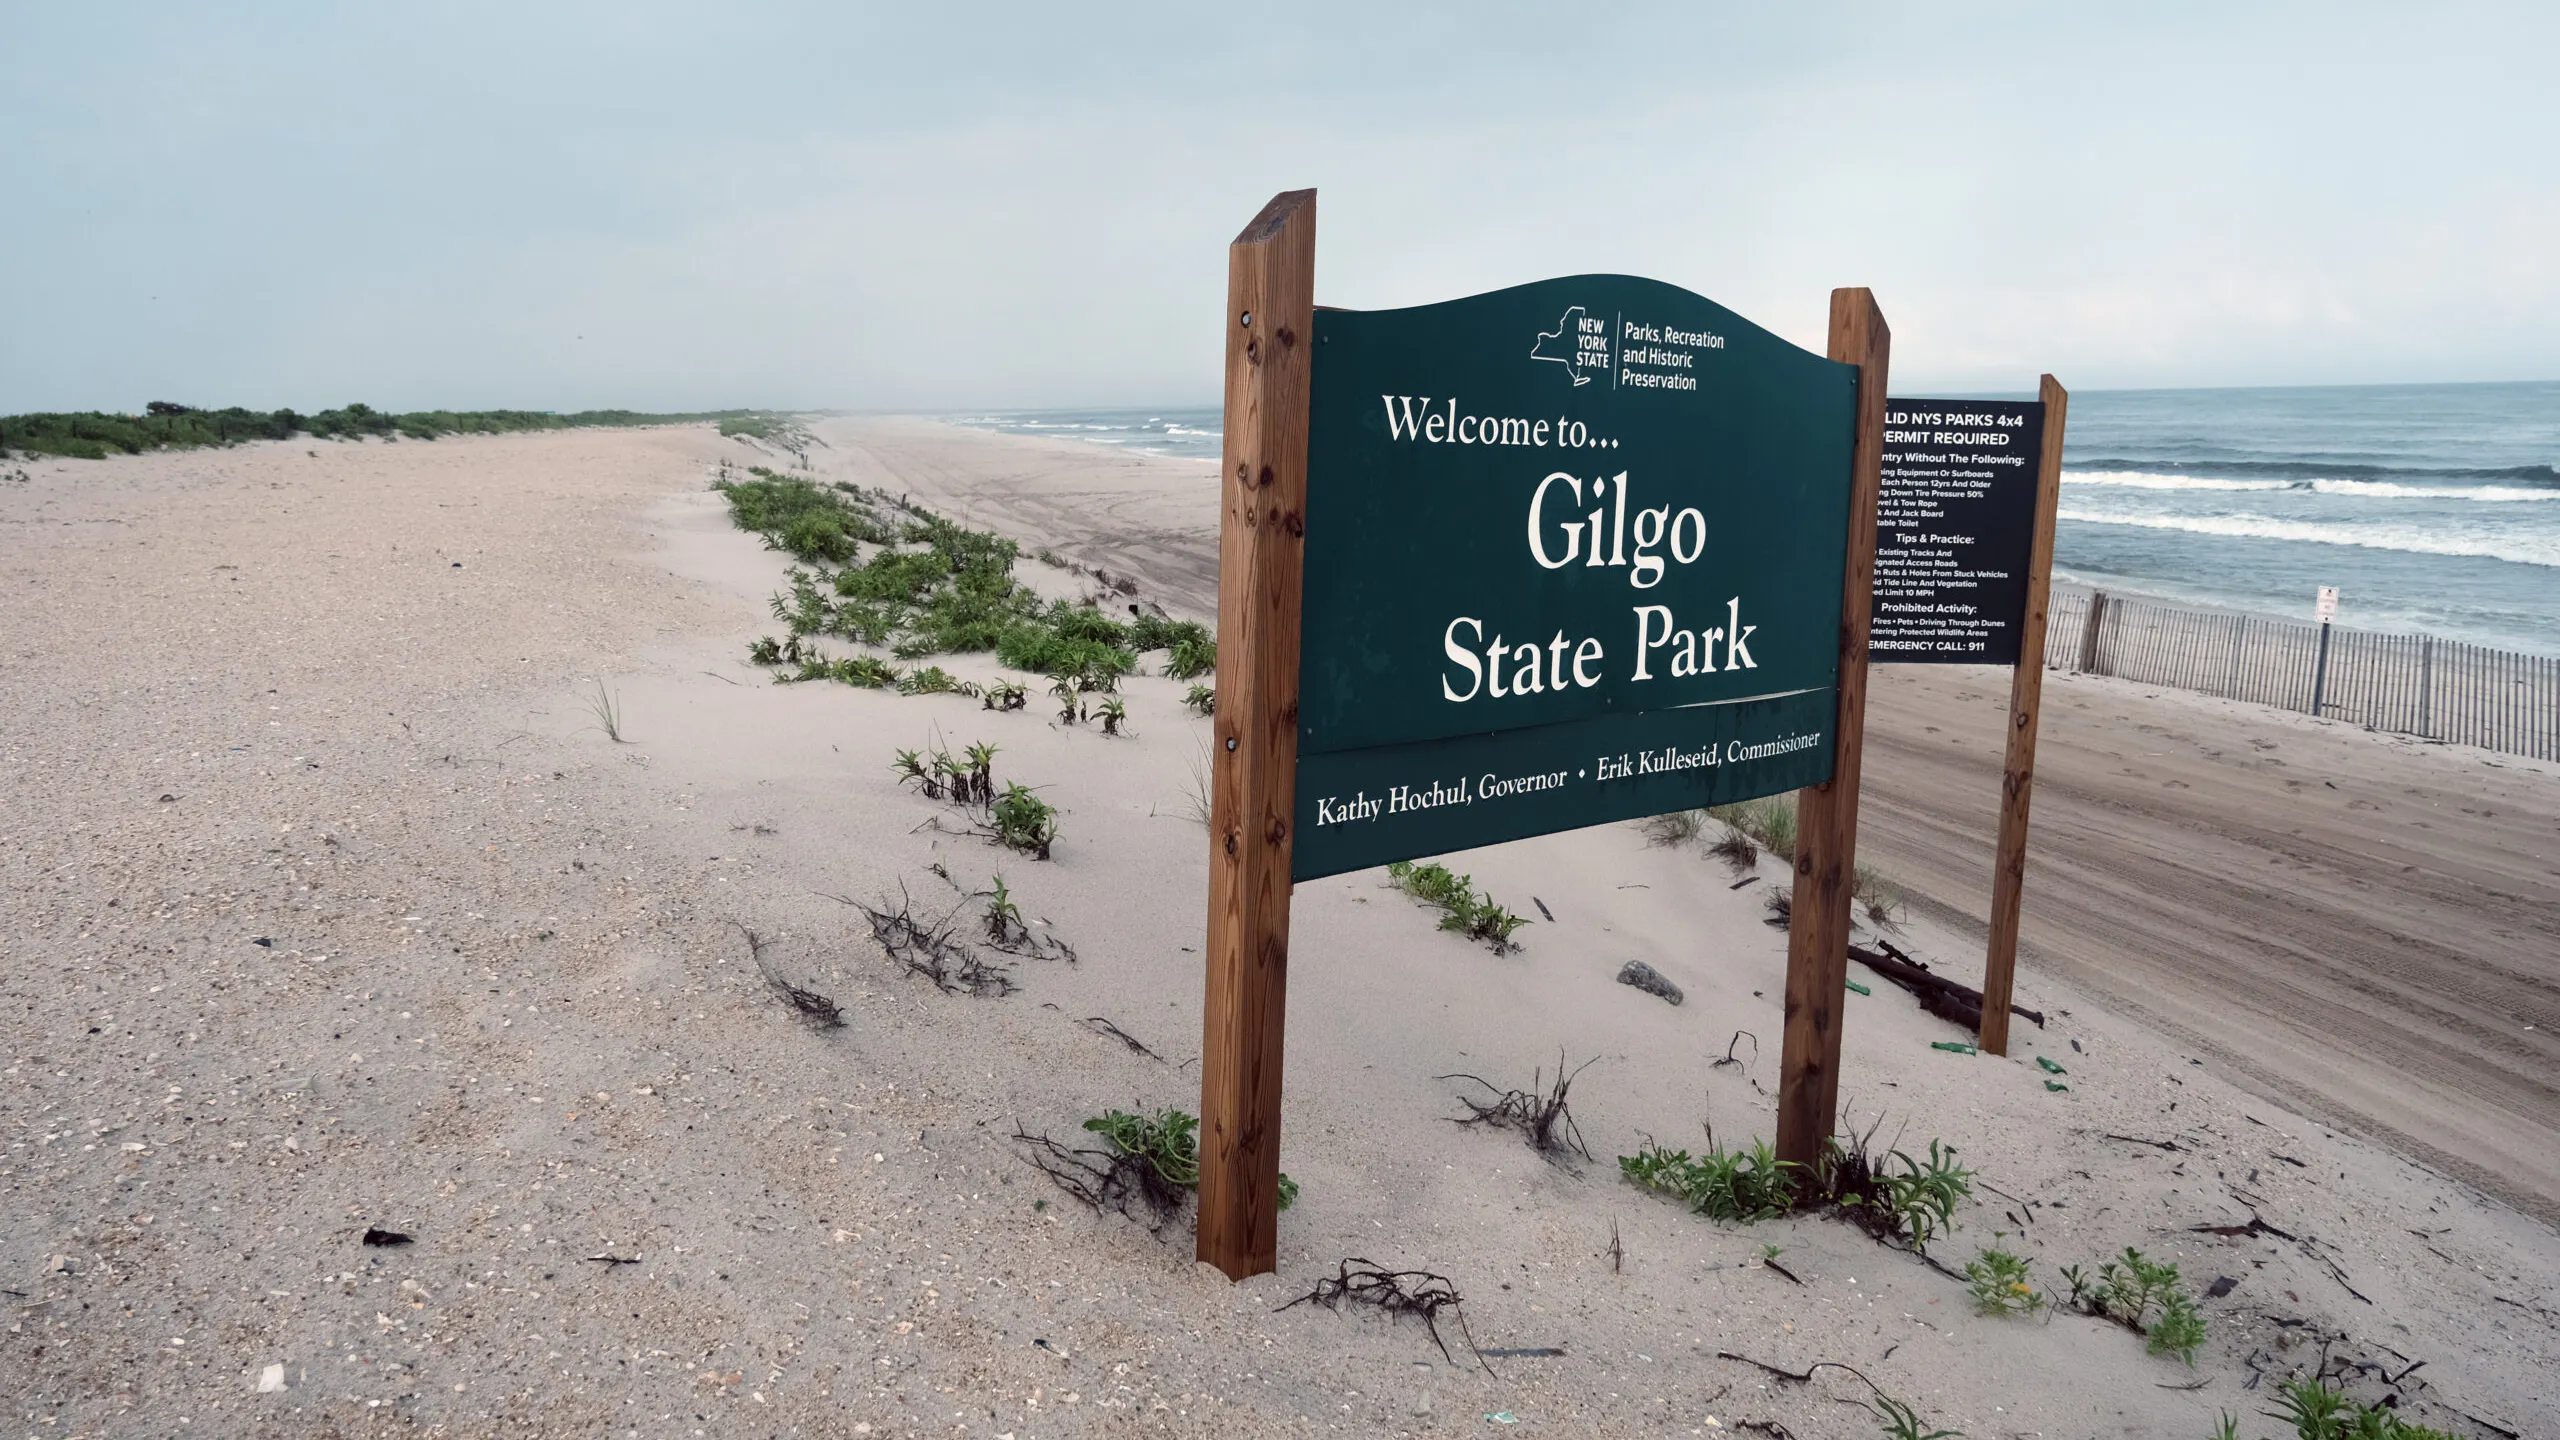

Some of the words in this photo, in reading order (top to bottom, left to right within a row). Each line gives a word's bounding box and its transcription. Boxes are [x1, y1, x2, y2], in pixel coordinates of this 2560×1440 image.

[1579, 317, 1604, 334] NEW
[1625, 321, 1662, 344] Parks,
[1665, 326, 1724, 349] Recreation
[1578, 334, 1608, 351] YORK
[1576, 351, 1609, 369] STATE
[1623, 346, 1646, 364] and
[1649, 349, 1693, 368] Historic
[1622, 368, 1697, 391] Preservation
[1382, 394, 1550, 447] Welcome
[1557, 415, 1619, 449] to...
[1885, 412, 1908, 424] LID
[1912, 412, 1942, 425] NYS
[1945, 414, 1993, 426] PARKS
[1997, 415, 2023, 427] 4x4
[1933, 432, 2010, 446] REQUIRED
[1881, 453, 1902, 464] ntry
[1905, 452, 1946, 463] Without
[1949, 454, 1968, 463] The
[1971, 454, 2025, 466] Following:
[1897, 468, 1938, 478] Equipment
[1940, 469, 1950, 477] Or
[1951, 469, 1994, 478] Surfboards
[1881, 478, 1900, 486] Each
[1902, 479, 1929, 487] Person
[1930, 480, 1950, 488] 12yrs
[1952, 480, 1968, 488] And
[1969, 480, 1991, 488] Older
[1915, 489, 1930, 497] Tire
[1931, 490, 1966, 498] Pressure
[1967, 490, 1984, 498] 50%
[1893, 499, 1899, 507] &
[1900, 499, 1916, 507] Tow
[1918, 500, 1938, 508] Rope
[1901, 509, 1919, 517] Jack
[1920, 510, 1944, 518] Board
[1877, 519, 1896, 527] table
[1898, 519, 1919, 527] Toilet
[1528, 470, 1707, 589] Gilgo
[1896, 533, 1917, 545] Tips
[1920, 535, 1927, 543] &
[1930, 534, 1975, 544] Practice:
[1878, 548, 1909, 557] Existing
[1910, 549, 1935, 557] Tracks
[1875, 558, 1904, 567] ignated
[1906, 559, 1933, 567] Access
[1909, 569, 1931, 577] Holes
[1954, 570, 1975, 578] Stuck
[1936, 580, 1978, 588] Vegetation
[1881, 602, 1934, 613] Prohibited
[1936, 604, 1978, 615] Activity:
[1897, 618, 1914, 626] Pets
[1919, 619, 1947, 627] Driving
[1948, 619, 1979, 628] Through
[1871, 628, 1897, 637] ntering
[1899, 628, 1936, 636] Protected
[1937, 629, 1965, 637] Wildlife
[1967, 629, 1988, 637] Areas
[1442, 616, 1603, 702] State
[1631, 595, 1758, 682] Park
[1868, 640, 1934, 650] EMERGENCY
[1936, 641, 1966, 651] CALL:
[1968, 642, 1985, 651] 911
[1316, 791, 1383, 826] Kathy
[1388, 777, 1472, 814] Hochul,
[1478, 771, 1568, 800] Governor
[1597, 753, 1634, 781] Erik
[1638, 742, 1722, 775] Kulleseid,
[1727, 731, 1821, 763] Commissioner
